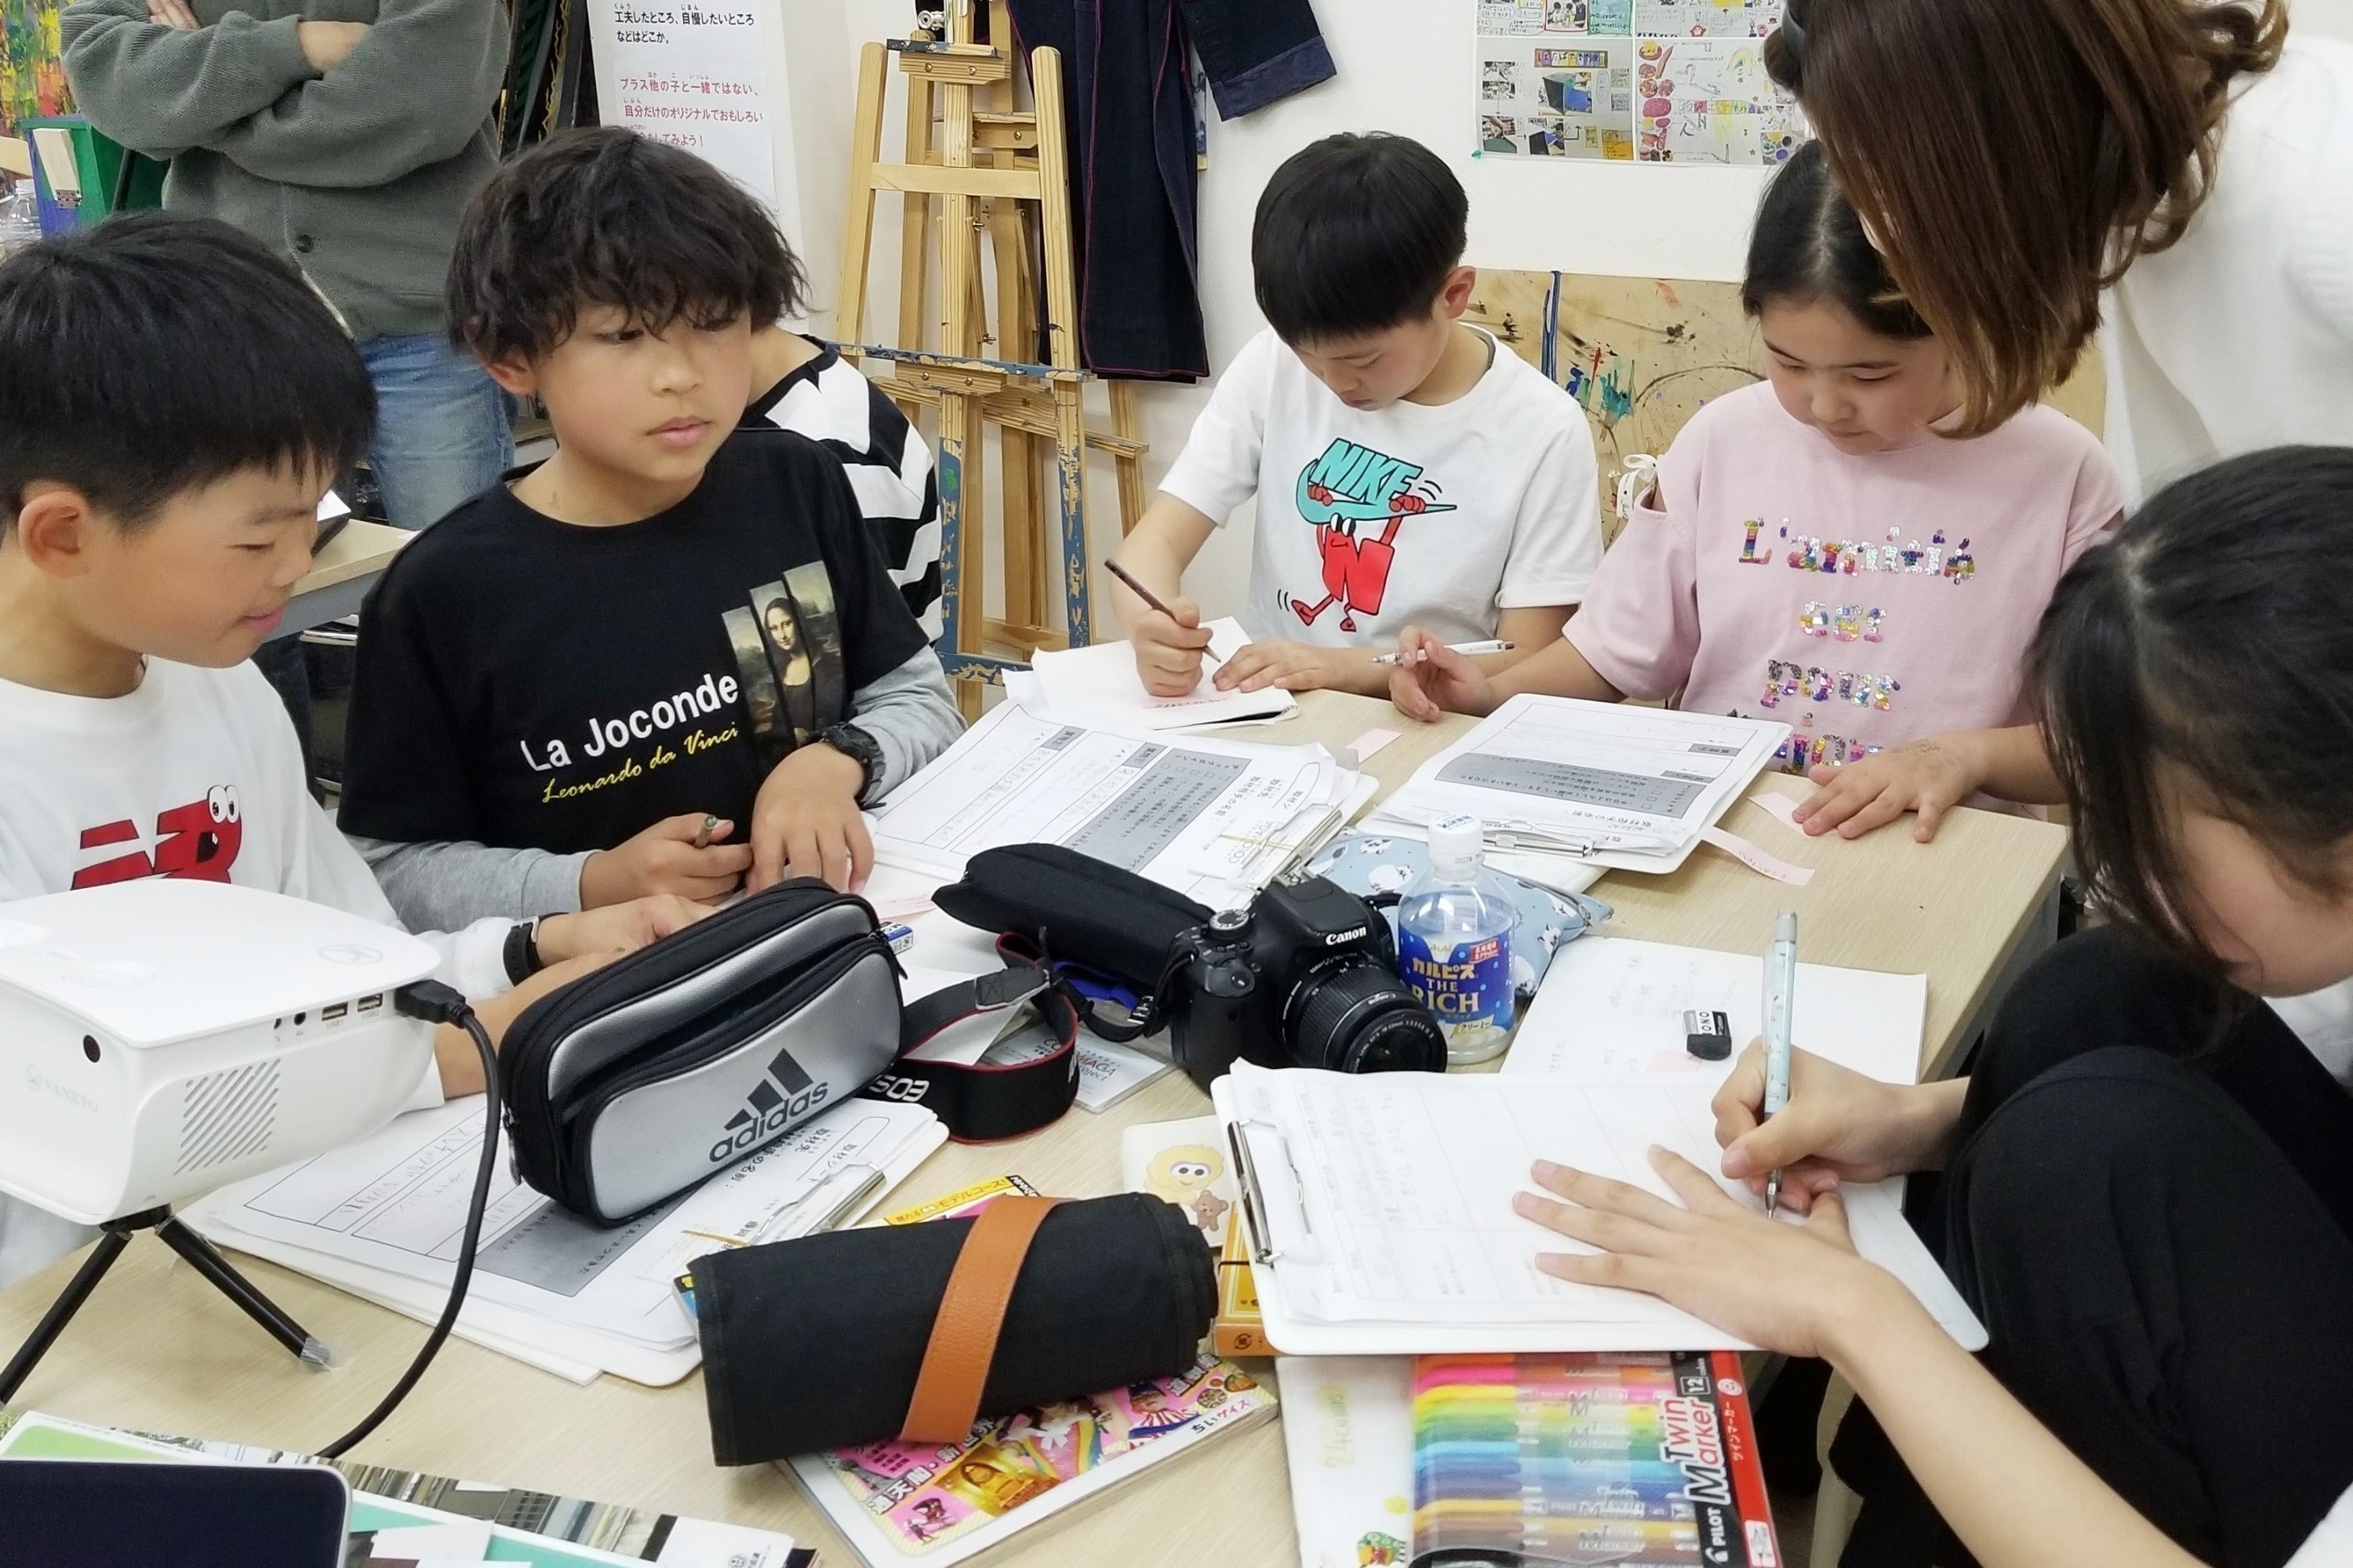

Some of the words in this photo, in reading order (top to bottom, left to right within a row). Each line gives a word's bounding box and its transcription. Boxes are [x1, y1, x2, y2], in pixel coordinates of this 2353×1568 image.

[615, 11, 755, 26] 工夫したところ、自慢したいところ
[617, 31, 670, 44] などはどこか。
[625, 106, 763, 122] 自分だけのオリジナルでおもしろい
[1308, 438, 1424, 504] NIKE
[520, 740, 572, 772] La
[583, 672, 739, 757] Joconde
[541, 763, 642, 803] Leonardo
[649, 745, 675, 770] da
[684, 722, 739, 756] Vinci
[1326, 926, 1366, 945] Canon
[1413, 957, 1475, 980] カルピス
[1412, 984, 1479, 1013] RICH
[1426, 978, 1457, 991] THE
[868, 1074, 929, 1102] EOS
[709, 1082, 829, 1163] adidas
[1662, 1399, 1693, 1458] Twin
[1688, 1400, 1729, 1501] Marker
[1708, 1507, 1725, 1545] PILOT
